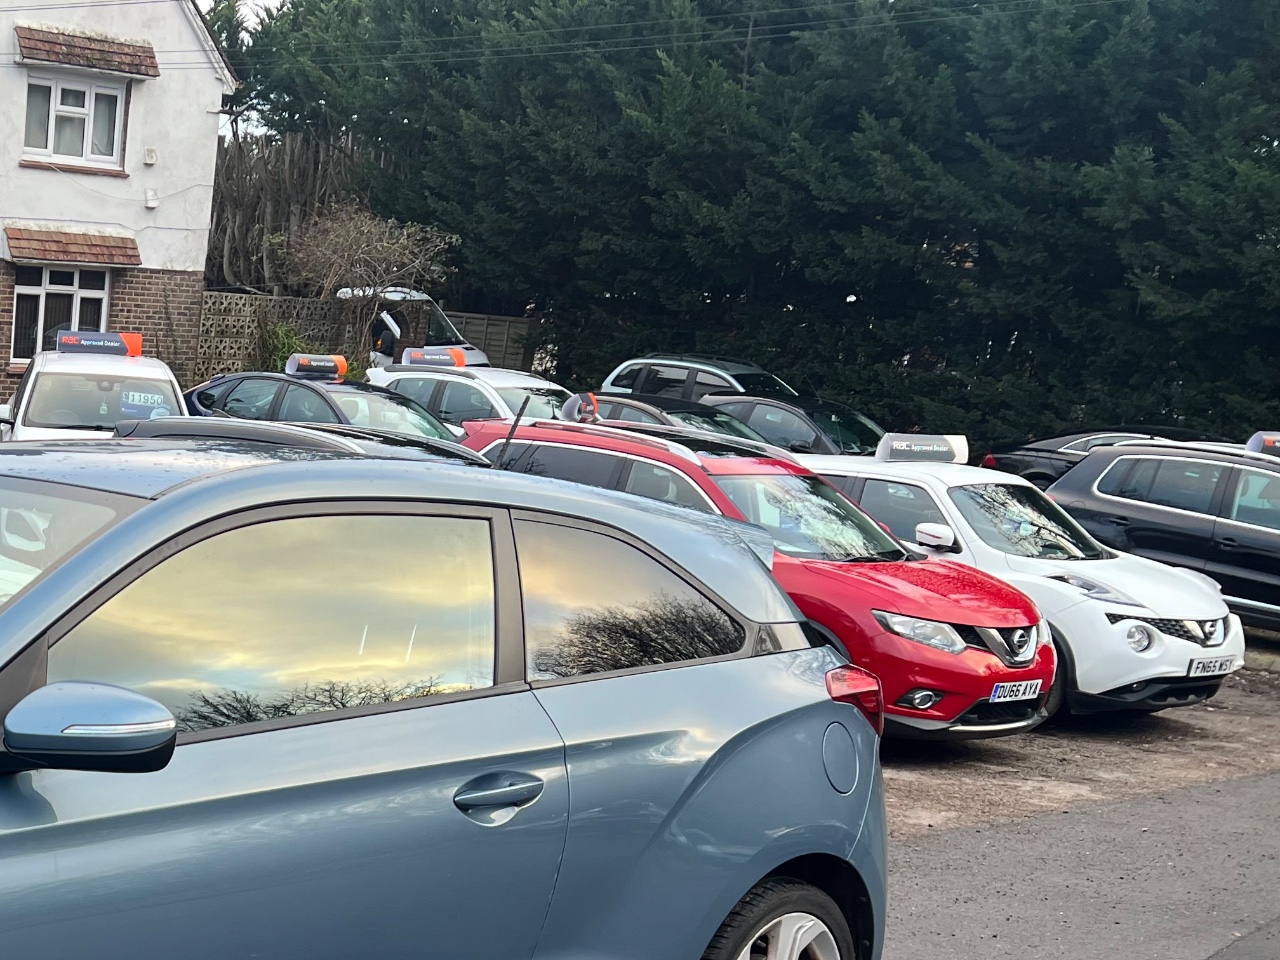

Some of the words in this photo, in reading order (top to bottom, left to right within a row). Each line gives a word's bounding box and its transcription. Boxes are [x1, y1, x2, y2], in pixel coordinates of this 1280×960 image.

[911, 444, 933, 452] Approved
[933, 444, 949, 452] Dealer
[997, 684, 1022, 699] DU66
[1021, 682, 1039, 697] AYA
